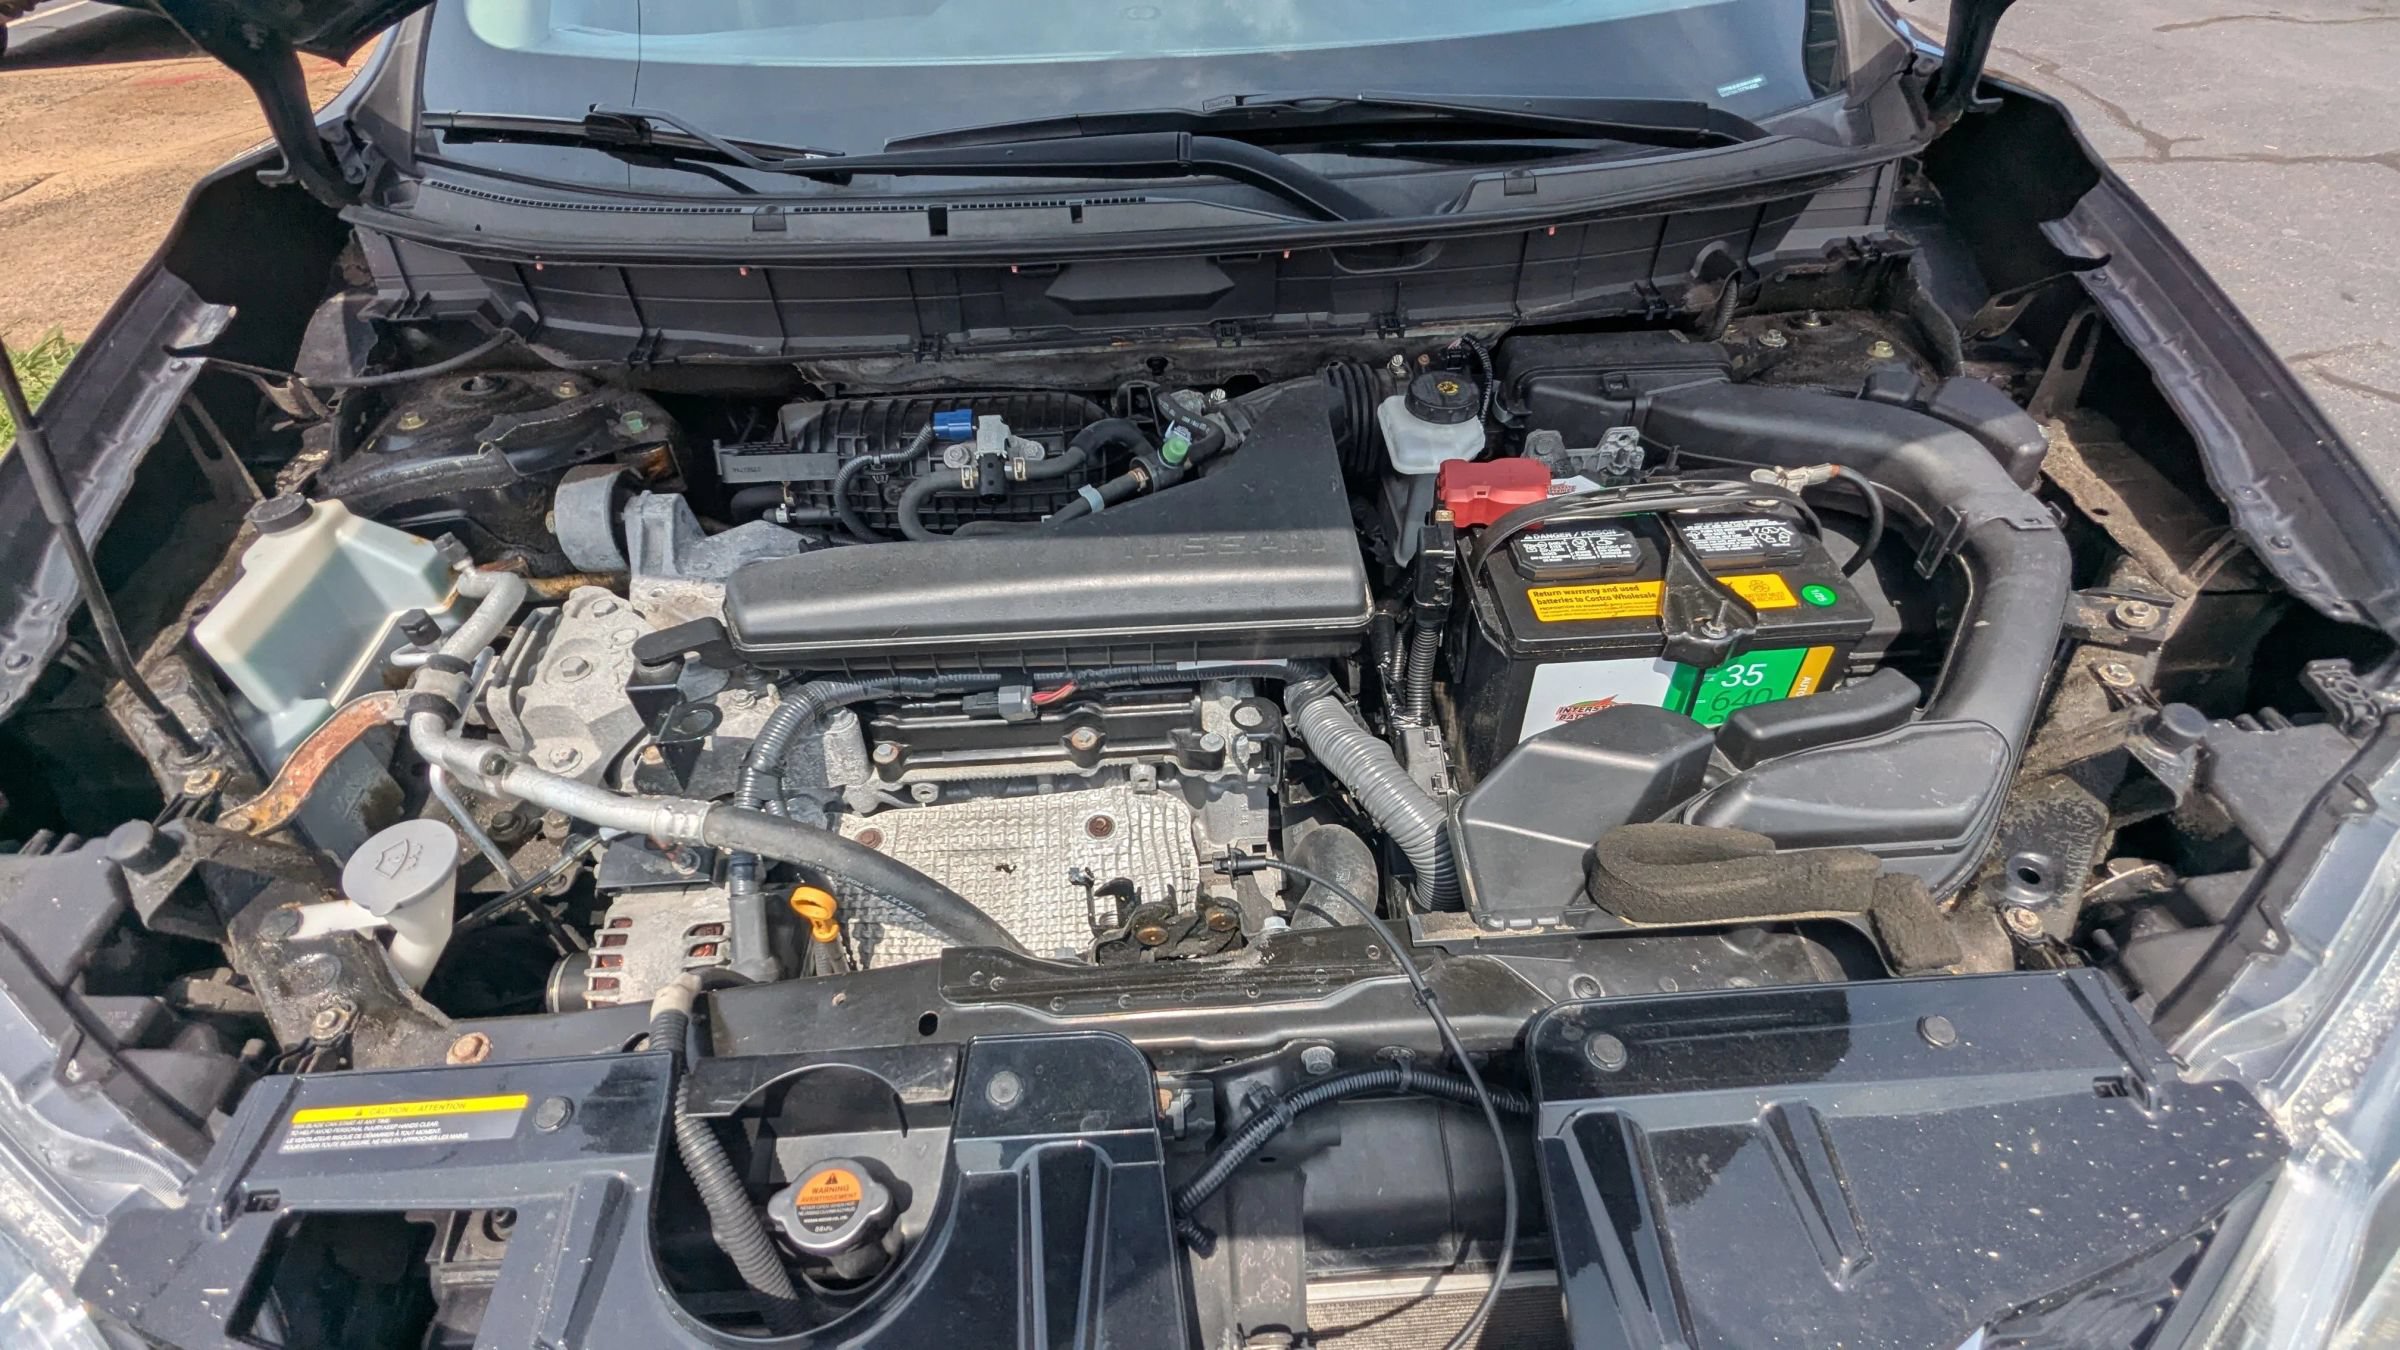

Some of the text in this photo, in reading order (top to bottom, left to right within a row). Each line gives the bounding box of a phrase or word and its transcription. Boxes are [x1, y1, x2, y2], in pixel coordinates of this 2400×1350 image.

[1533, 532, 1572, 540] DANGER
[1581, 529, 1617, 538] POISON
[1563, 587, 1600, 596] warranty
[1536, 597, 1574, 605] batteries
[1584, 594, 1612, 602] Costco
[1613, 592, 1657, 600] Wholesale
[1720, 663, 1768, 688] 35
[1711, 687, 1773, 712] 640
[883, 895, 928, 917] GALAXY
[367, 1105, 410, 1114] CAUTION
[417, 1101, 467, 1111] ATTENTION
[812, 1185, 849, 1194] WARNING
[801, 1192, 858, 1202] AVERTISSEMENT
